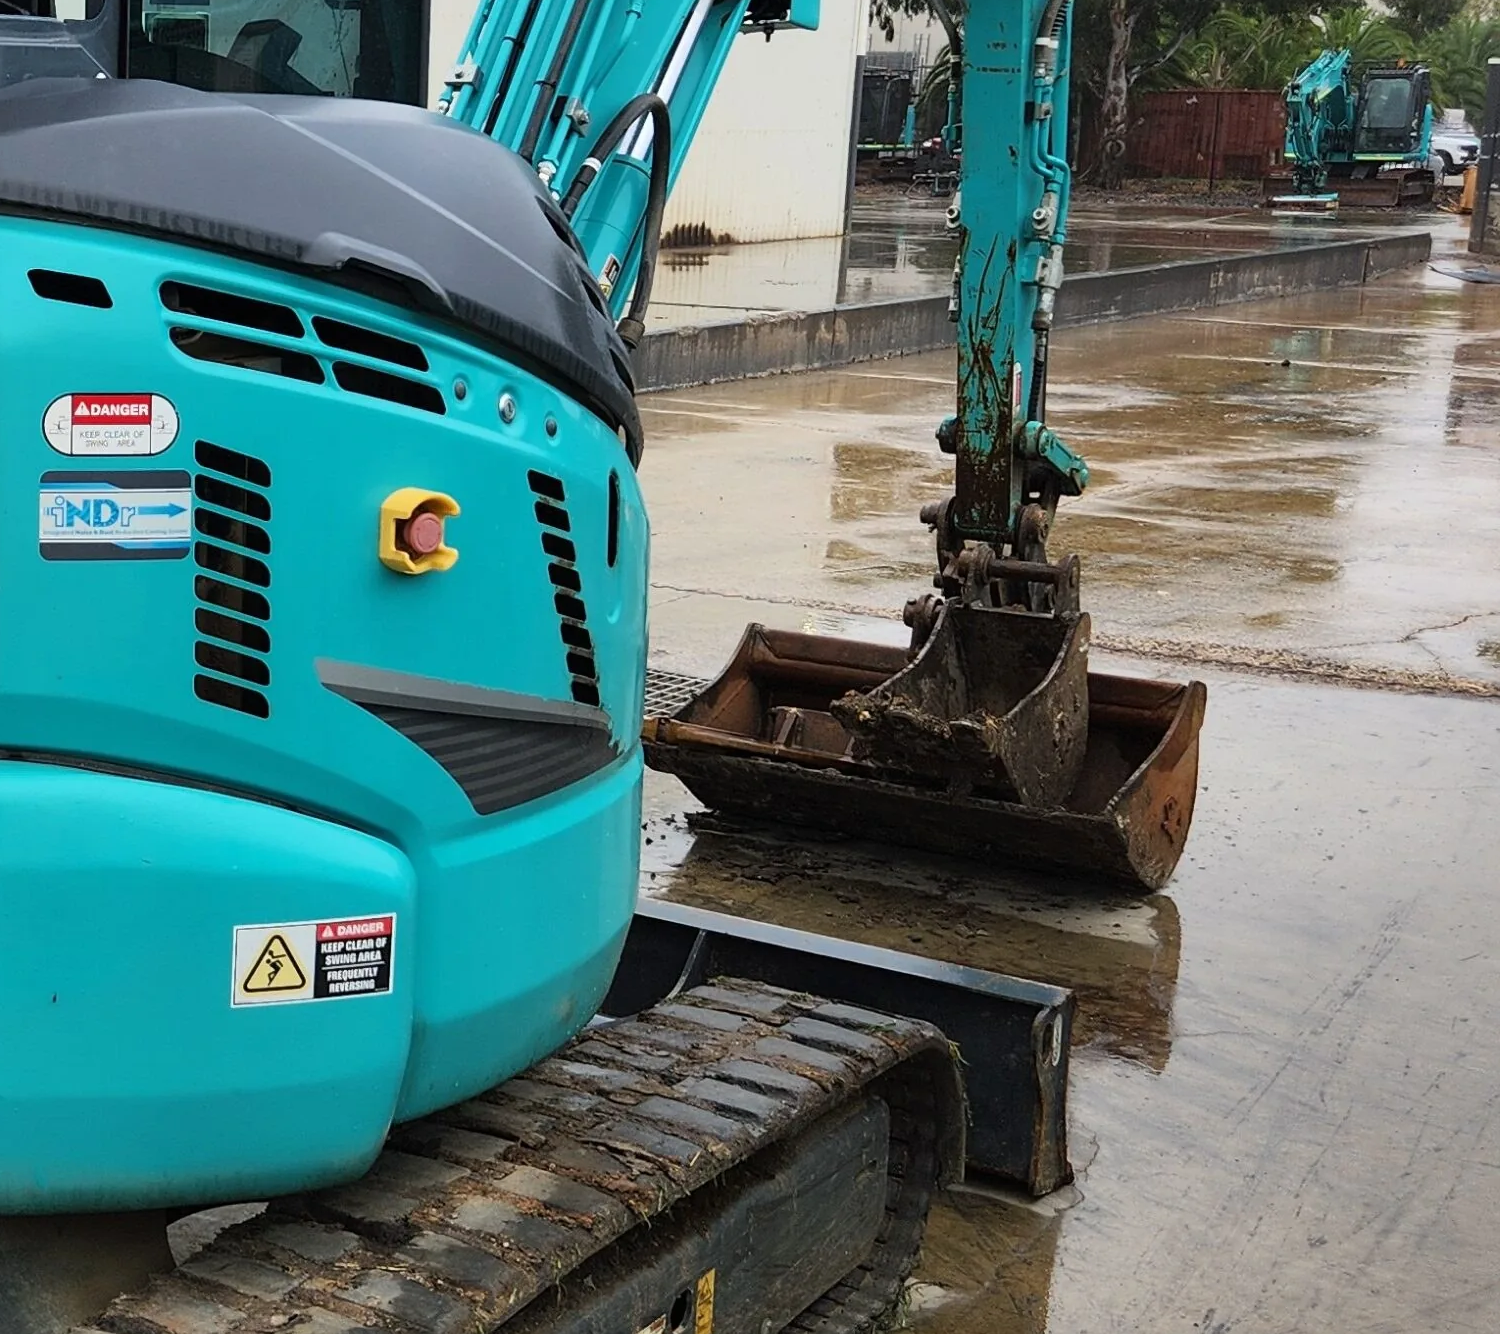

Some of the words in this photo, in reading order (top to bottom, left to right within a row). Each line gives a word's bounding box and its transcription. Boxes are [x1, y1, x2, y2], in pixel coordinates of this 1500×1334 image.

[90, 403, 149, 416] DANGER
[79, 430, 100, 439] KEEP
[104, 430, 131, 439] CLEAR
[133, 430, 145, 438] OF
[85, 440, 109, 448] SWING
[336, 921, 385, 936] DANGER
[321, 941, 345, 954] KEEP
[345, 939, 374, 951] CLEAR
[375, 937, 387, 948] OF
[325, 953, 357, 966] SWING
[357, 950, 382, 962] AREA
[327, 967, 378, 981] FREQUENTLY
[328, 979, 375, 993] REVERSING
